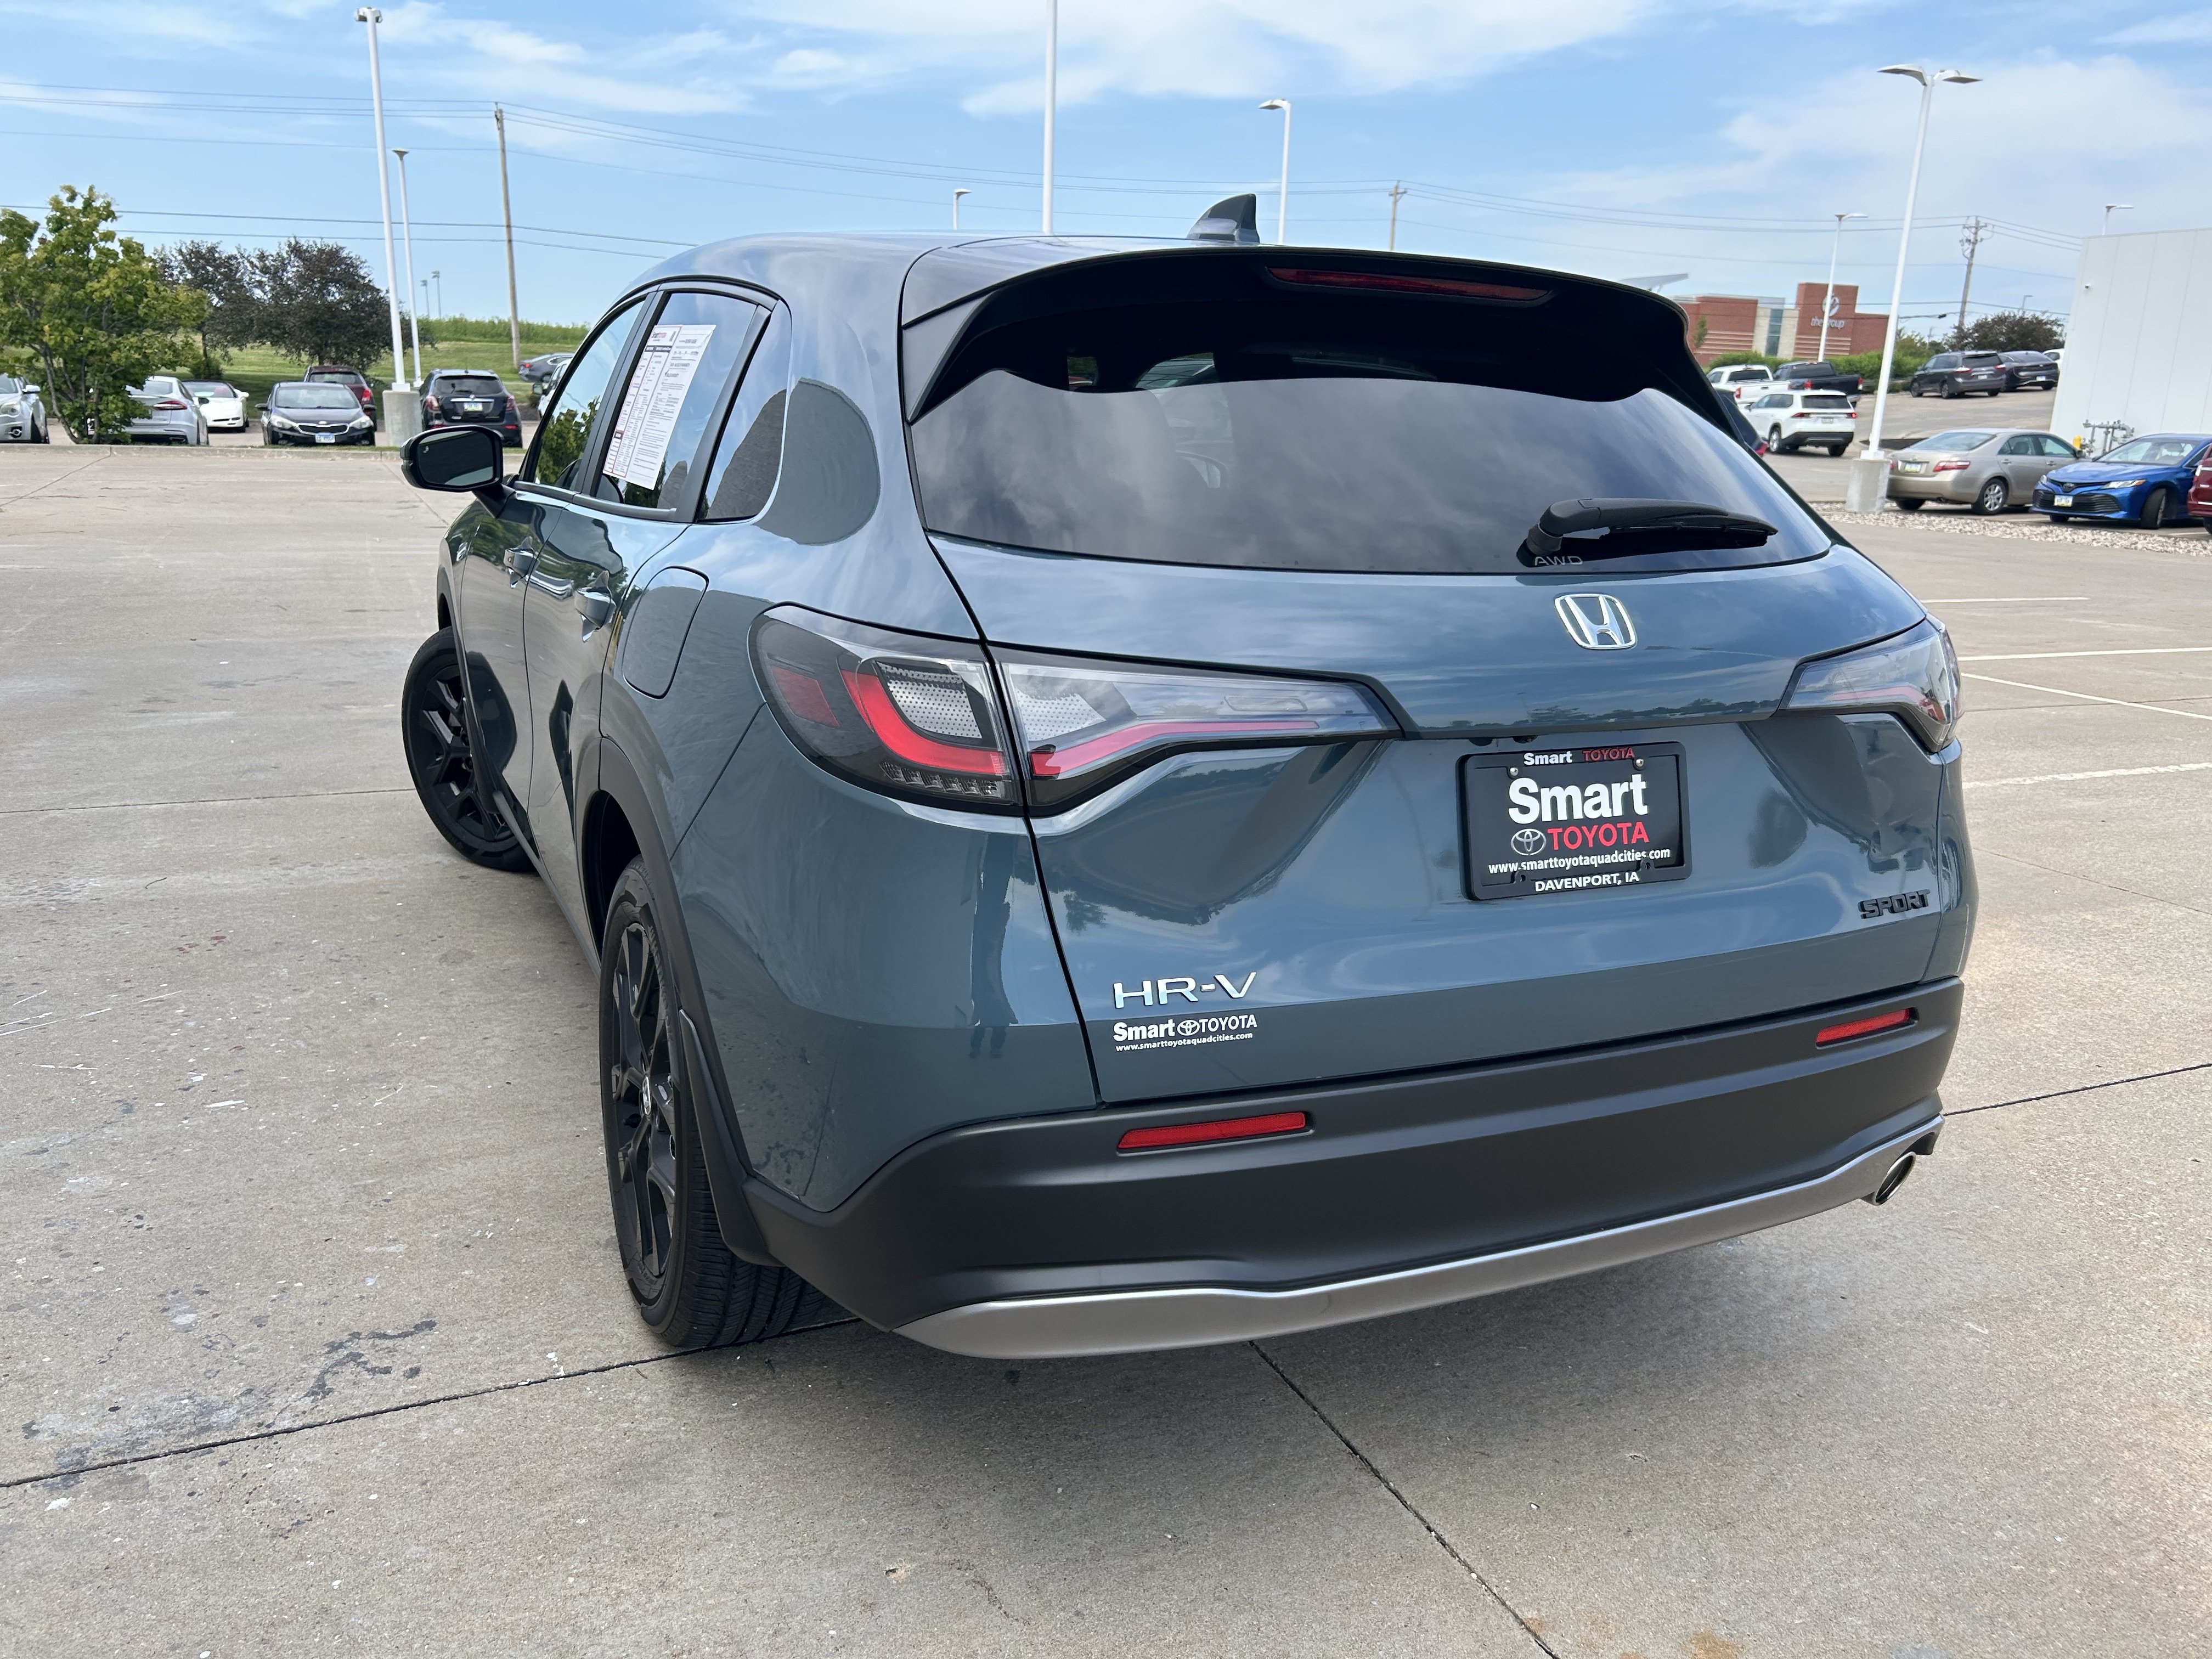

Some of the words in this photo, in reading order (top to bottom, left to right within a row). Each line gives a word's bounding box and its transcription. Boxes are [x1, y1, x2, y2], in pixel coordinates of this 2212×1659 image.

[1534, 556, 1583, 566] AWD
[1523, 751, 1572, 765] Smart
[1583, 748, 1635, 761] TOYOTA
[1508, 774, 1648, 824] Smart
[1547, 822, 1649, 850] TOYOTA
[1488, 848, 1671, 874] www.smarttoyotaquadcitiescom
[1535, 873, 1622, 892] DAVENPORT,
[1625, 872, 1639, 883] IA
[1858, 889, 1931, 919] SPORT
[1113, 972, 1256, 1008] HR-V
[1113, 1019, 1175, 1041] Smart
[1199, 1014, 1257, 1032] TOYOTA
[1116, 1032, 1253, 1052] www.smarttoyotaquadcities.com
